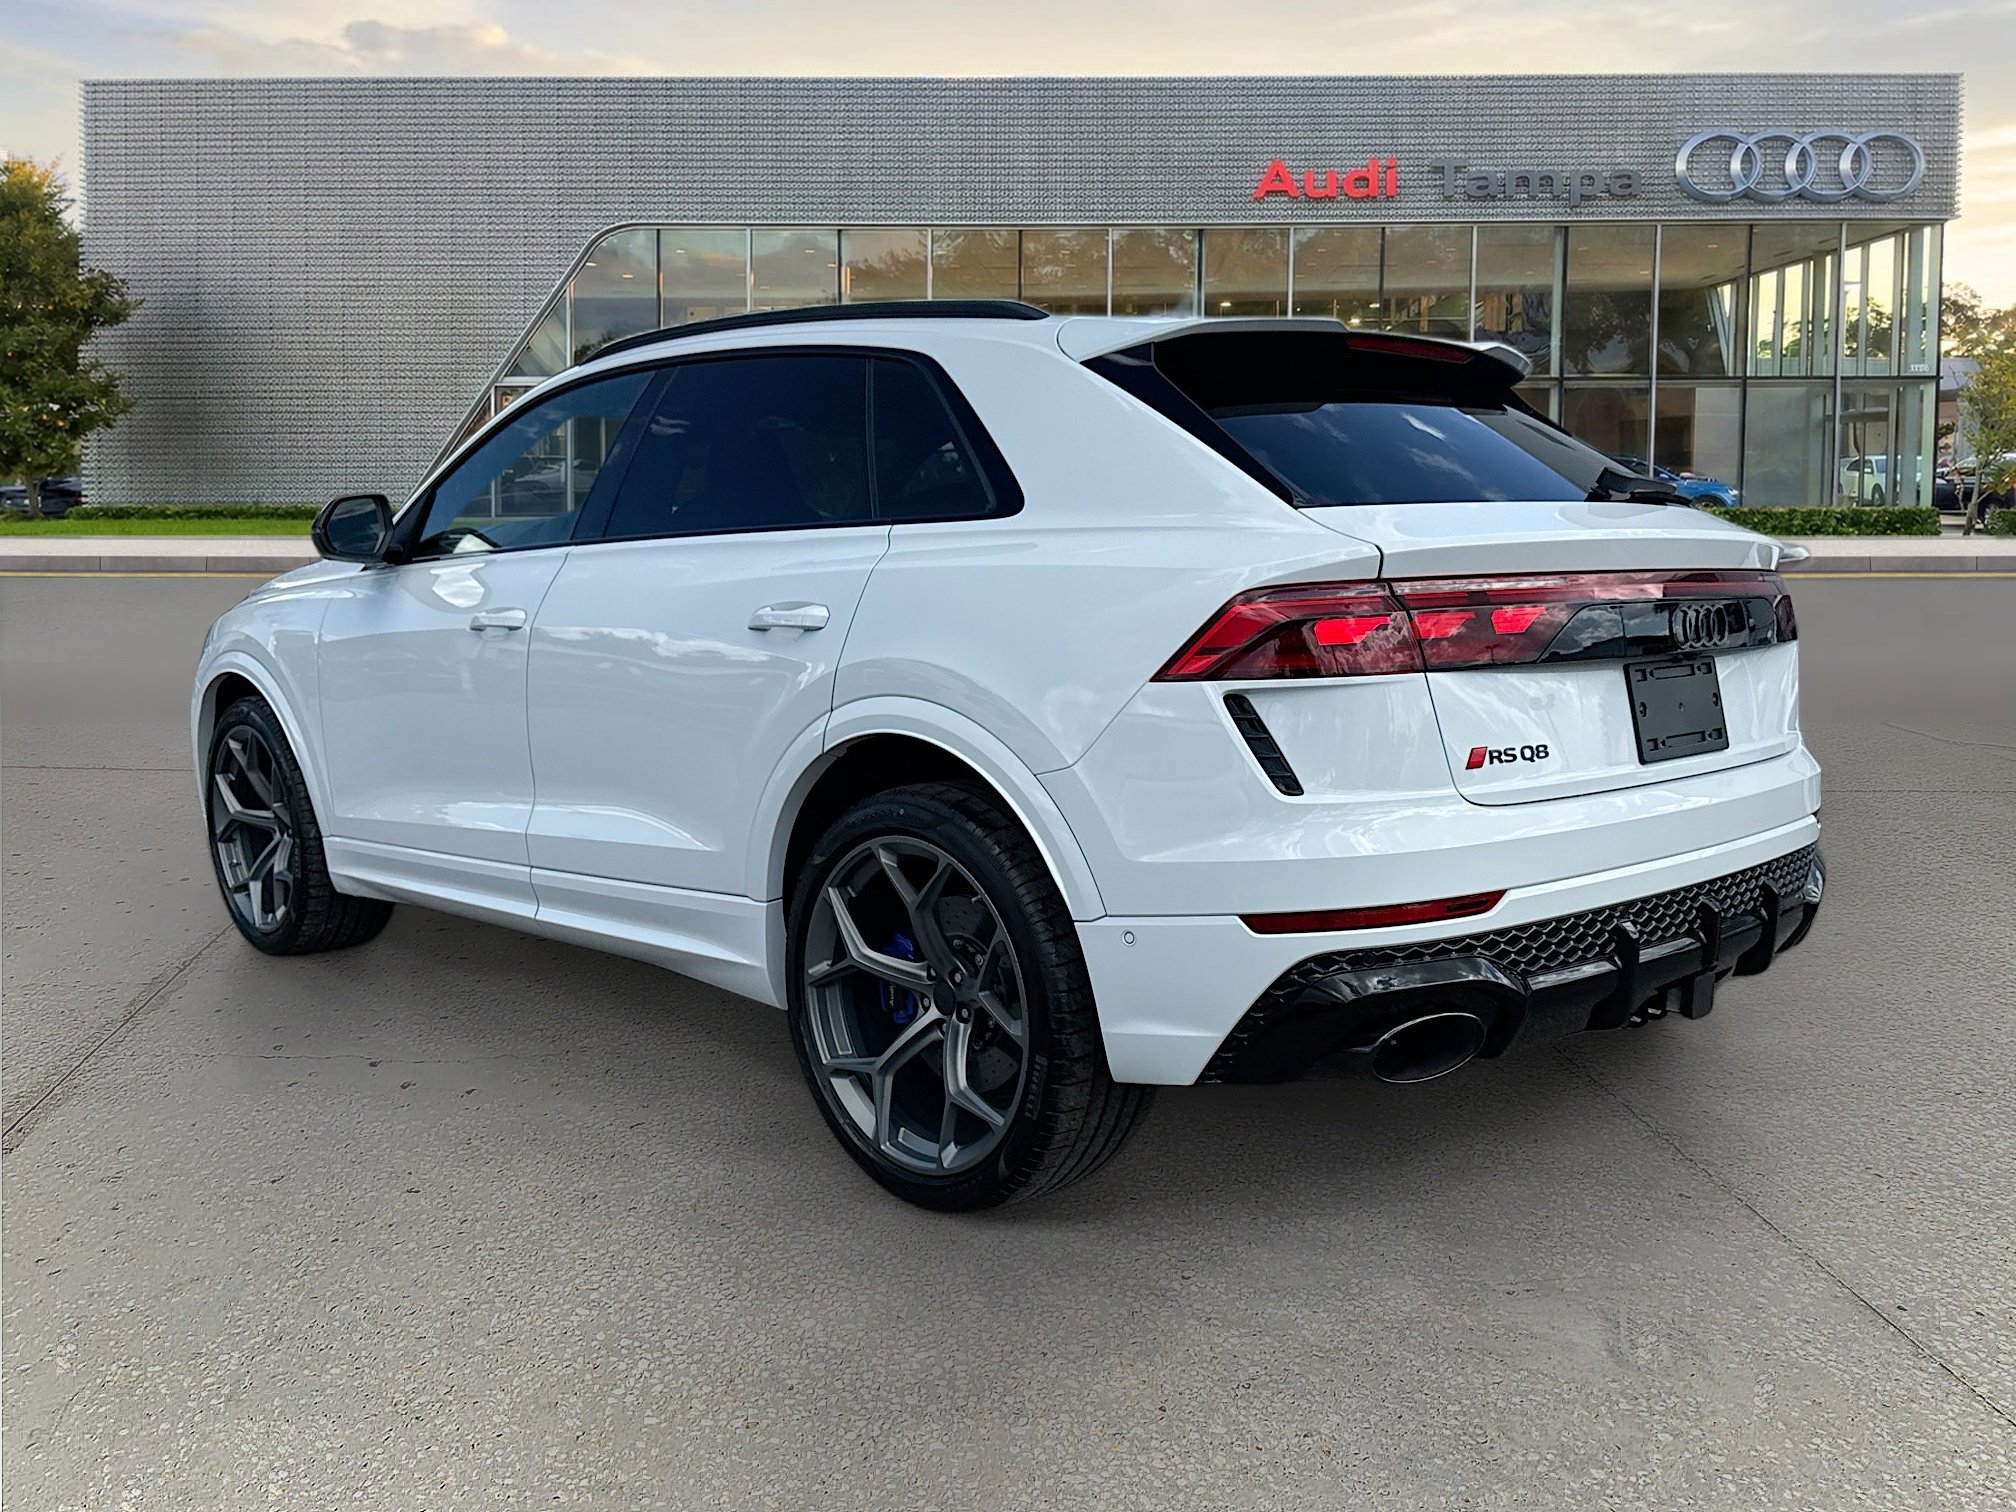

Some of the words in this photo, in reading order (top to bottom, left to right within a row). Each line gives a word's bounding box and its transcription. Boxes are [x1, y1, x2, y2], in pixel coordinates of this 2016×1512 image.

[1253, 157, 1398, 200] Audi
[1430, 158, 1642, 208] Tampa
[1488, 747, 1518, 765] RS
[1520, 744, 1550, 763] Q8
